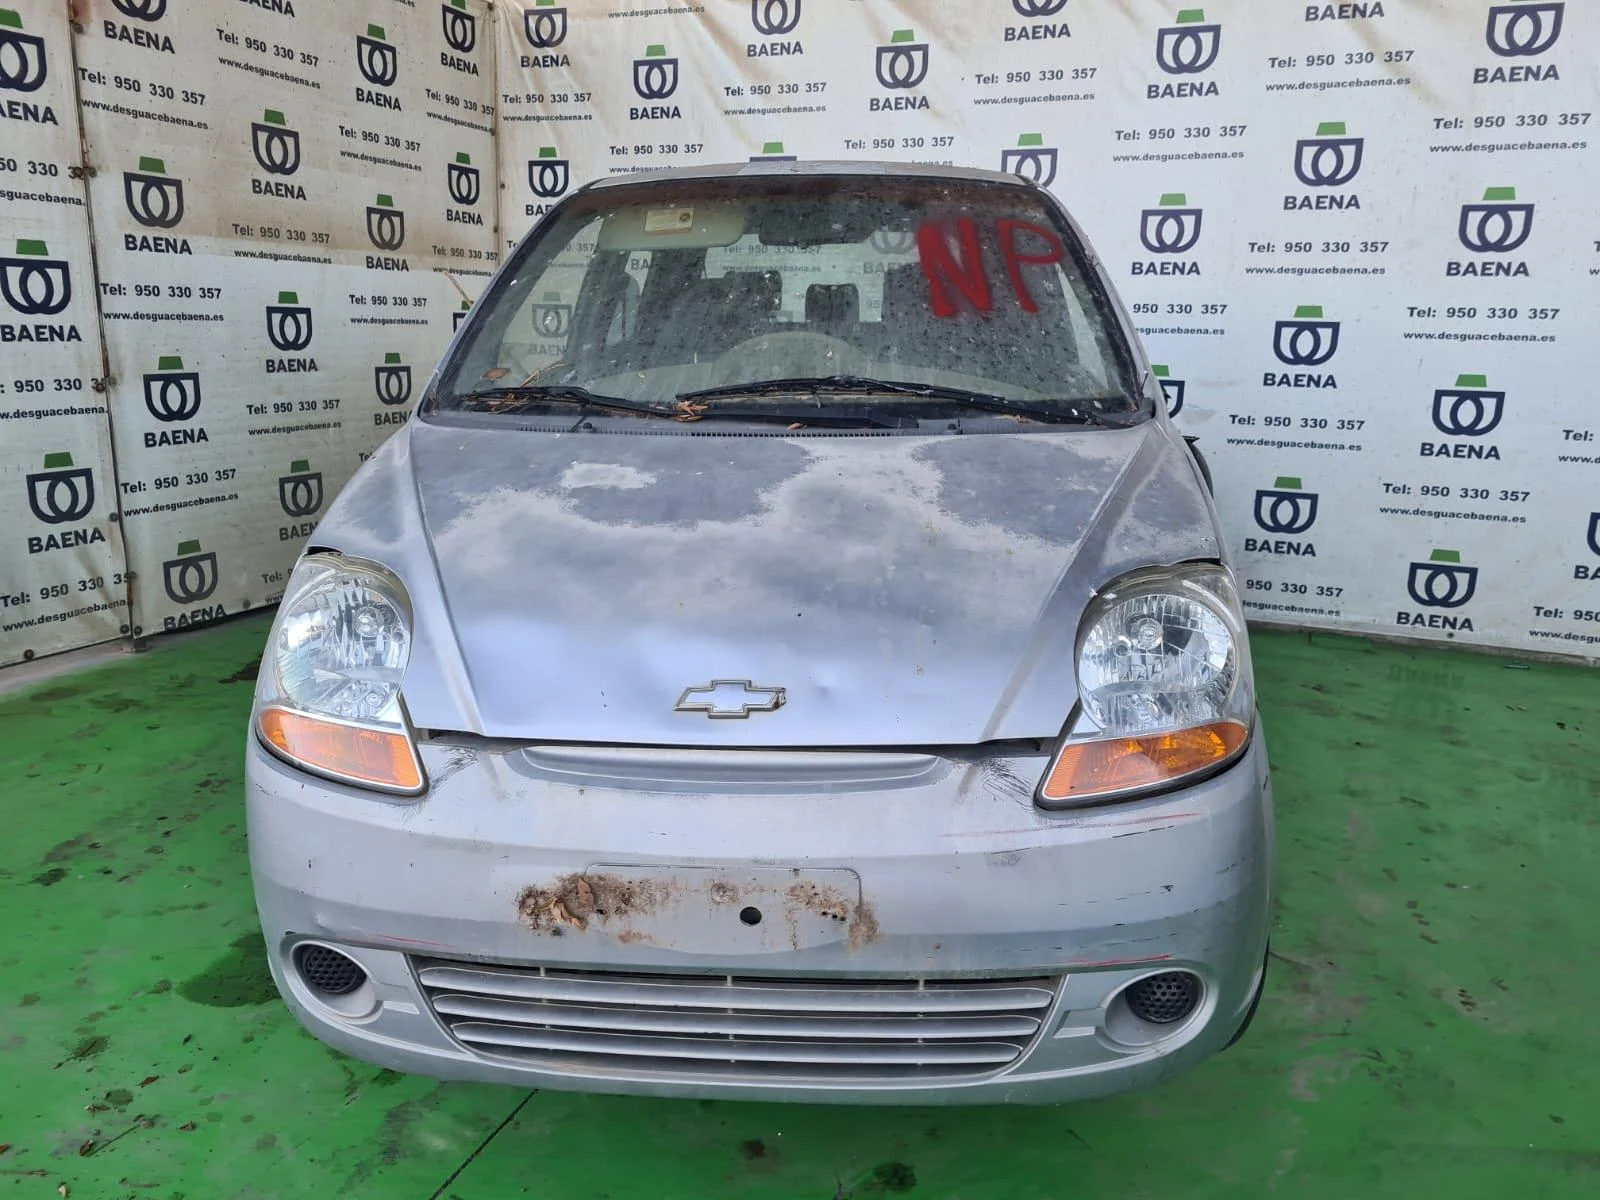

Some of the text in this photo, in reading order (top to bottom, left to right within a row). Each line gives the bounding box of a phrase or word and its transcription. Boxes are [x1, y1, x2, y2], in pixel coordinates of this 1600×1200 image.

[608, 6, 705, 18] www.desguacebaena.es
[1305, 2, 1384, 21] BAENA
[104, 20, 175, 54] BAENA
[1005, 24, 1071, 41] BAENA
[216, 28, 318, 67] Tel: 950 330 357
[747, 41, 803, 57] BAENA
[441, 52, 479, 76] BAENA
[521, 55, 570, 68] BAENA
[1268, 50, 1414, 68] Tel: 950 330 357
[218, 55, 321, 90] www.desguacebaena.es
[975, 68, 1096, 84] Tel: 950 330 357
[1473, 65, 1559, 84] BAENA
[79, 67, 206, 106] Tel: 950 330 357
[724, 82, 826, 96] Tel: 950 330 357
[1147, 81, 1219, 99] BAENA
[1266, 78, 1411, 91] www.desguacebaena.es
[356, 88, 401, 111] BAENA
[425, 89, 494, 117] Tel: 950 330 357
[502, 93, 591, 104] Tel: 950 330 357
[870, 96, 930, 111] BAENA
[974, 94, 1094, 105] www.desguacebaena.es
[81, 99, 209, 130] www.desguacebaena.es
[503, 114, 592, 122] www.desguacebaena.es
[630, 106, 681, 120] BAENA
[724, 106, 826, 116] www.desguacebaena.es
[1434, 113, 1591, 129] Tel: 950 330 357
[339, 125, 420, 152] Tel: 950 330 357
[1115, 126, 1247, 140] Tel: 950 330 357
[610, 144, 703, 155] Tel: 950 330 357
[844, 137, 955, 149] Tel: 950 330 357
[1430, 141, 1586, 153] www.desguacebaena.es
[340, 151, 421, 171] www.desguacebaena.es
[1112, 150, 1244, 162] www.desguacebaena.es
[28, 161, 58, 176] 330
[252, 179, 306, 200] BAENA
[1284, 195, 1360, 210] BAENA
[447, 209, 483, 226] BAENA
[232, 224, 329, 244] Tel: 950 330 357
[124, 234, 192, 255] BAENA
[1248, 242, 1389, 252] Tel: 950 330 357
[234, 250, 332, 264] www.desguacebaena.es
[432, 245, 498, 261] Tel: 950 330 357
[366, 256, 409, 272] BAENA
[915, 217, 1064, 317] NP
[1132, 262, 1200, 275] BAENA
[1246, 266, 1385, 276] www.desguacebaena.es
[1446, 262, 1529, 276] BAENA
[101, 283, 221, 299] Tel: 950 330 357
[349, 294, 427, 307] Tel: 950 330 357
[104, 311, 224, 322] www.desguacebaena.es
[1133, 304, 1227, 314] 950 330 357
[1407, 307, 1560, 319] Tel: 950 330 357
[350, 317, 428, 326] www.desguacebaena.es
[0, 325, 82, 342] BAENA
[1404, 332, 1555, 342] www.desguacebaena.es
[266, 358, 318, 373] BAENA
[14, 380, 44, 393] 950
[54, 378, 82, 391] 330
[1263, 373, 1337, 388] BAENA
[246, 399, 341, 415] Tel: 950 330 357
[248, 422, 341, 435] www.desguacebaena.es
[1230, 415, 1365, 430] Tel: 950 330 357
[144, 428, 209, 448] BAENA
[1563, 430, 1593, 441] Tel:
[1227, 438, 1361, 451] www.desguacebaena.es
[1420, 443, 1500, 460] BAENA
[120, 468, 237, 494] Tel: 950 330 357
[1383, 483, 1530, 502] Tel: 950 330 357
[124, 493, 238, 517] www.desguacebaena.es
[1380, 508, 1526, 523] www.desguacebaena.es
[28, 527, 105, 554] BAENA
[1244, 538, 1316, 556] BAENA
[262, 569, 283, 584] Tel:
[0, 576, 104, 607] Tel: 950 330
[1247, 579, 1343, 597] 950 330 357
[1397, 612, 1473, 632] BAENA
[1534, 606, 1600, 622] Tel: 950
